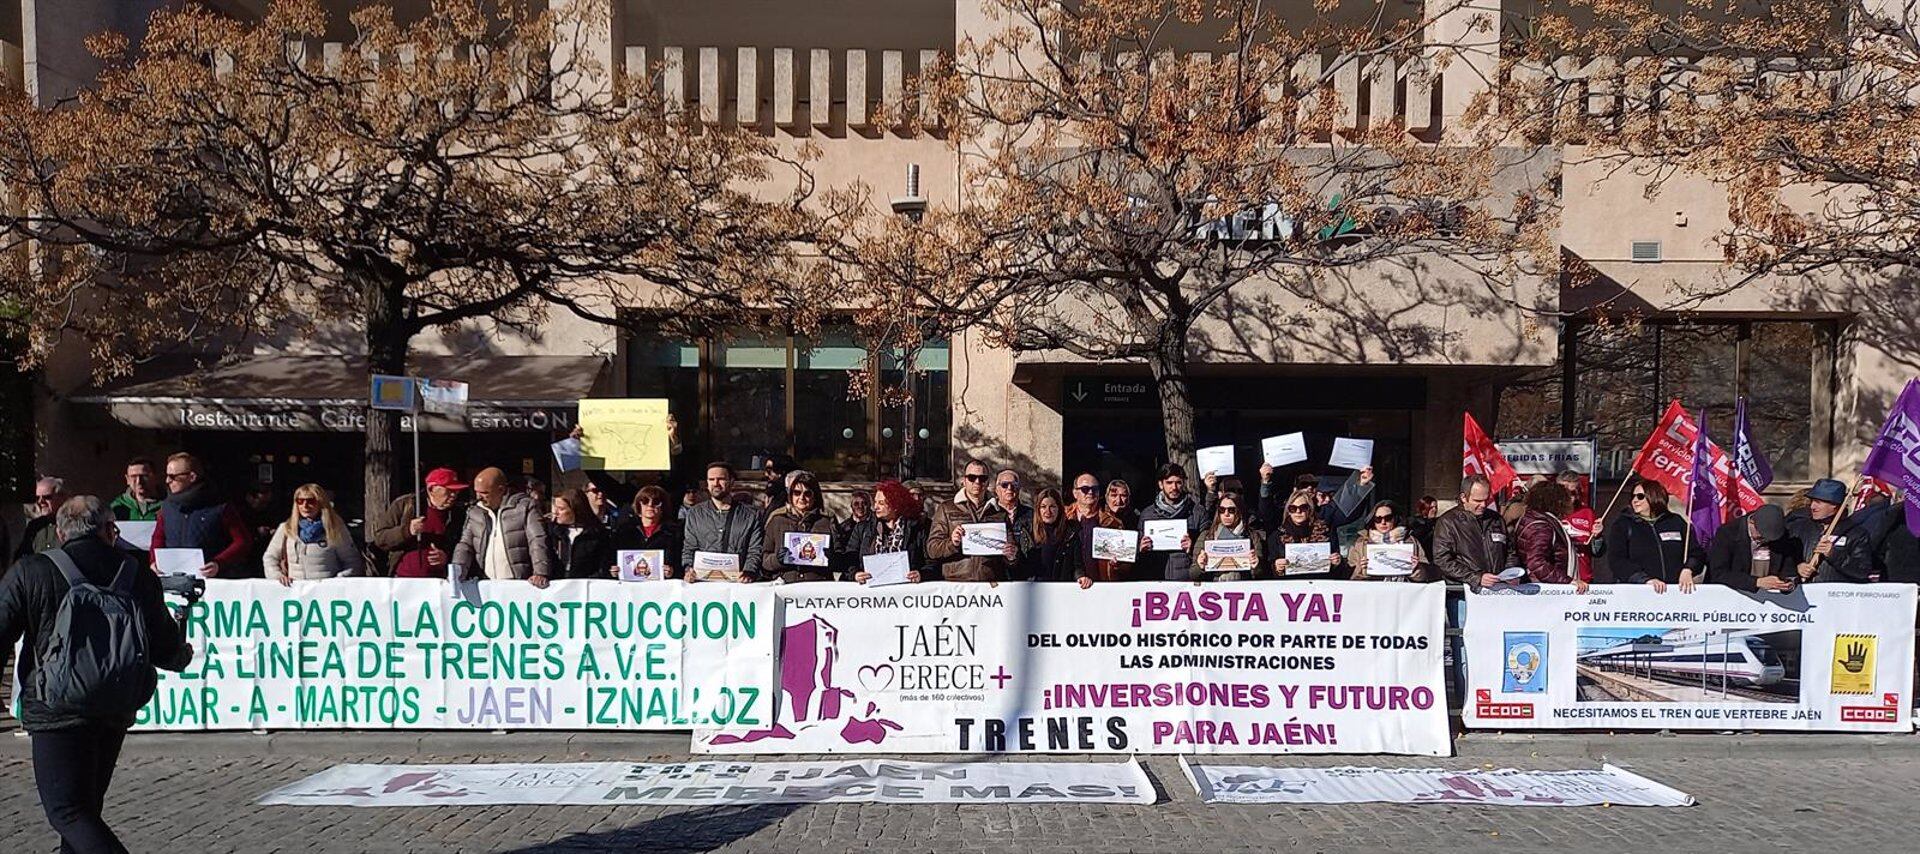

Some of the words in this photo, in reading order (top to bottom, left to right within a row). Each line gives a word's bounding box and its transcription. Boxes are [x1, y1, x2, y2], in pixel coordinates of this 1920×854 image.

[1104, 383, 1146, 393] Entrada
[179, 408, 300, 427] Restaurante
[785, 596, 898, 609] PLATAFORMA
[903, 595, 1003, 608] CIUDADANA
[1131, 591, 1269, 628] ¡BASTA
[1280, 593, 1344, 623] YA!
[165, 600, 270, 638] RMA
[282, 600, 382, 638] PARA
[393, 600, 439, 638] LA
[450, 601, 756, 639] CONSTRUCCION
[1564, 612, 1590, 622] POR
[1593, 612, 1610, 622] UN
[1613, 612, 1700, 623] FERROCARRIL
[1703, 610, 1757, 623] PÚBLICO
[1759, 613, 1768, 623] Y
[1770, 613, 1815, 623] SOCIAL
[889, 617, 977, 663] JAÉN
[1027, 634, 1061, 648] DEL
[1066, 634, 1132, 648] OLVIDO
[1137, 630, 1233, 648] HISTÓRICO
[1238, 634, 1275, 648] POR
[1281, 635, 1337, 649] PARTE
[1342, 635, 1366, 649] DE
[1370, 635, 1429, 650] TODAS
[179, 642, 225, 680] A
[236, 641, 346, 680] LINEA
[357, 642, 406, 680] DE
[416, 643, 565, 680] TRENES
[577, 643, 677, 681] A.V.E.
[1120, 655, 1154, 669] LAS
[1158, 655, 1335, 670] ADMINISTRACIONES
[249, 686, 268, 724] A
[296, 685, 420, 724] MARTOS
[457, 687, 553, 724] JAEN
[899, 694, 918, 703] (más
[919, 694, 929, 702] de
[1043, 682, 1270, 710] ¡INVERSIONES
[1278, 685, 1299, 709] Y
[1309, 685, 1435, 710] FUTURO
[1553, 708, 1638, 718] NECESITAMOS
[1641, 709, 1656, 718] EL
[1658, 708, 1691, 718] TREN
[1694, 709, 1720, 720] QUE
[1723, 709, 1788, 720] VERTEBRE
[955, 716, 1128, 751] TRENES
[1153, 720, 1239, 745] PARA
[1247, 717, 1338, 745] JAÉN!
[602, 784, 925, 800] MERECE
[949, 783, 1141, 799] MÁS!
